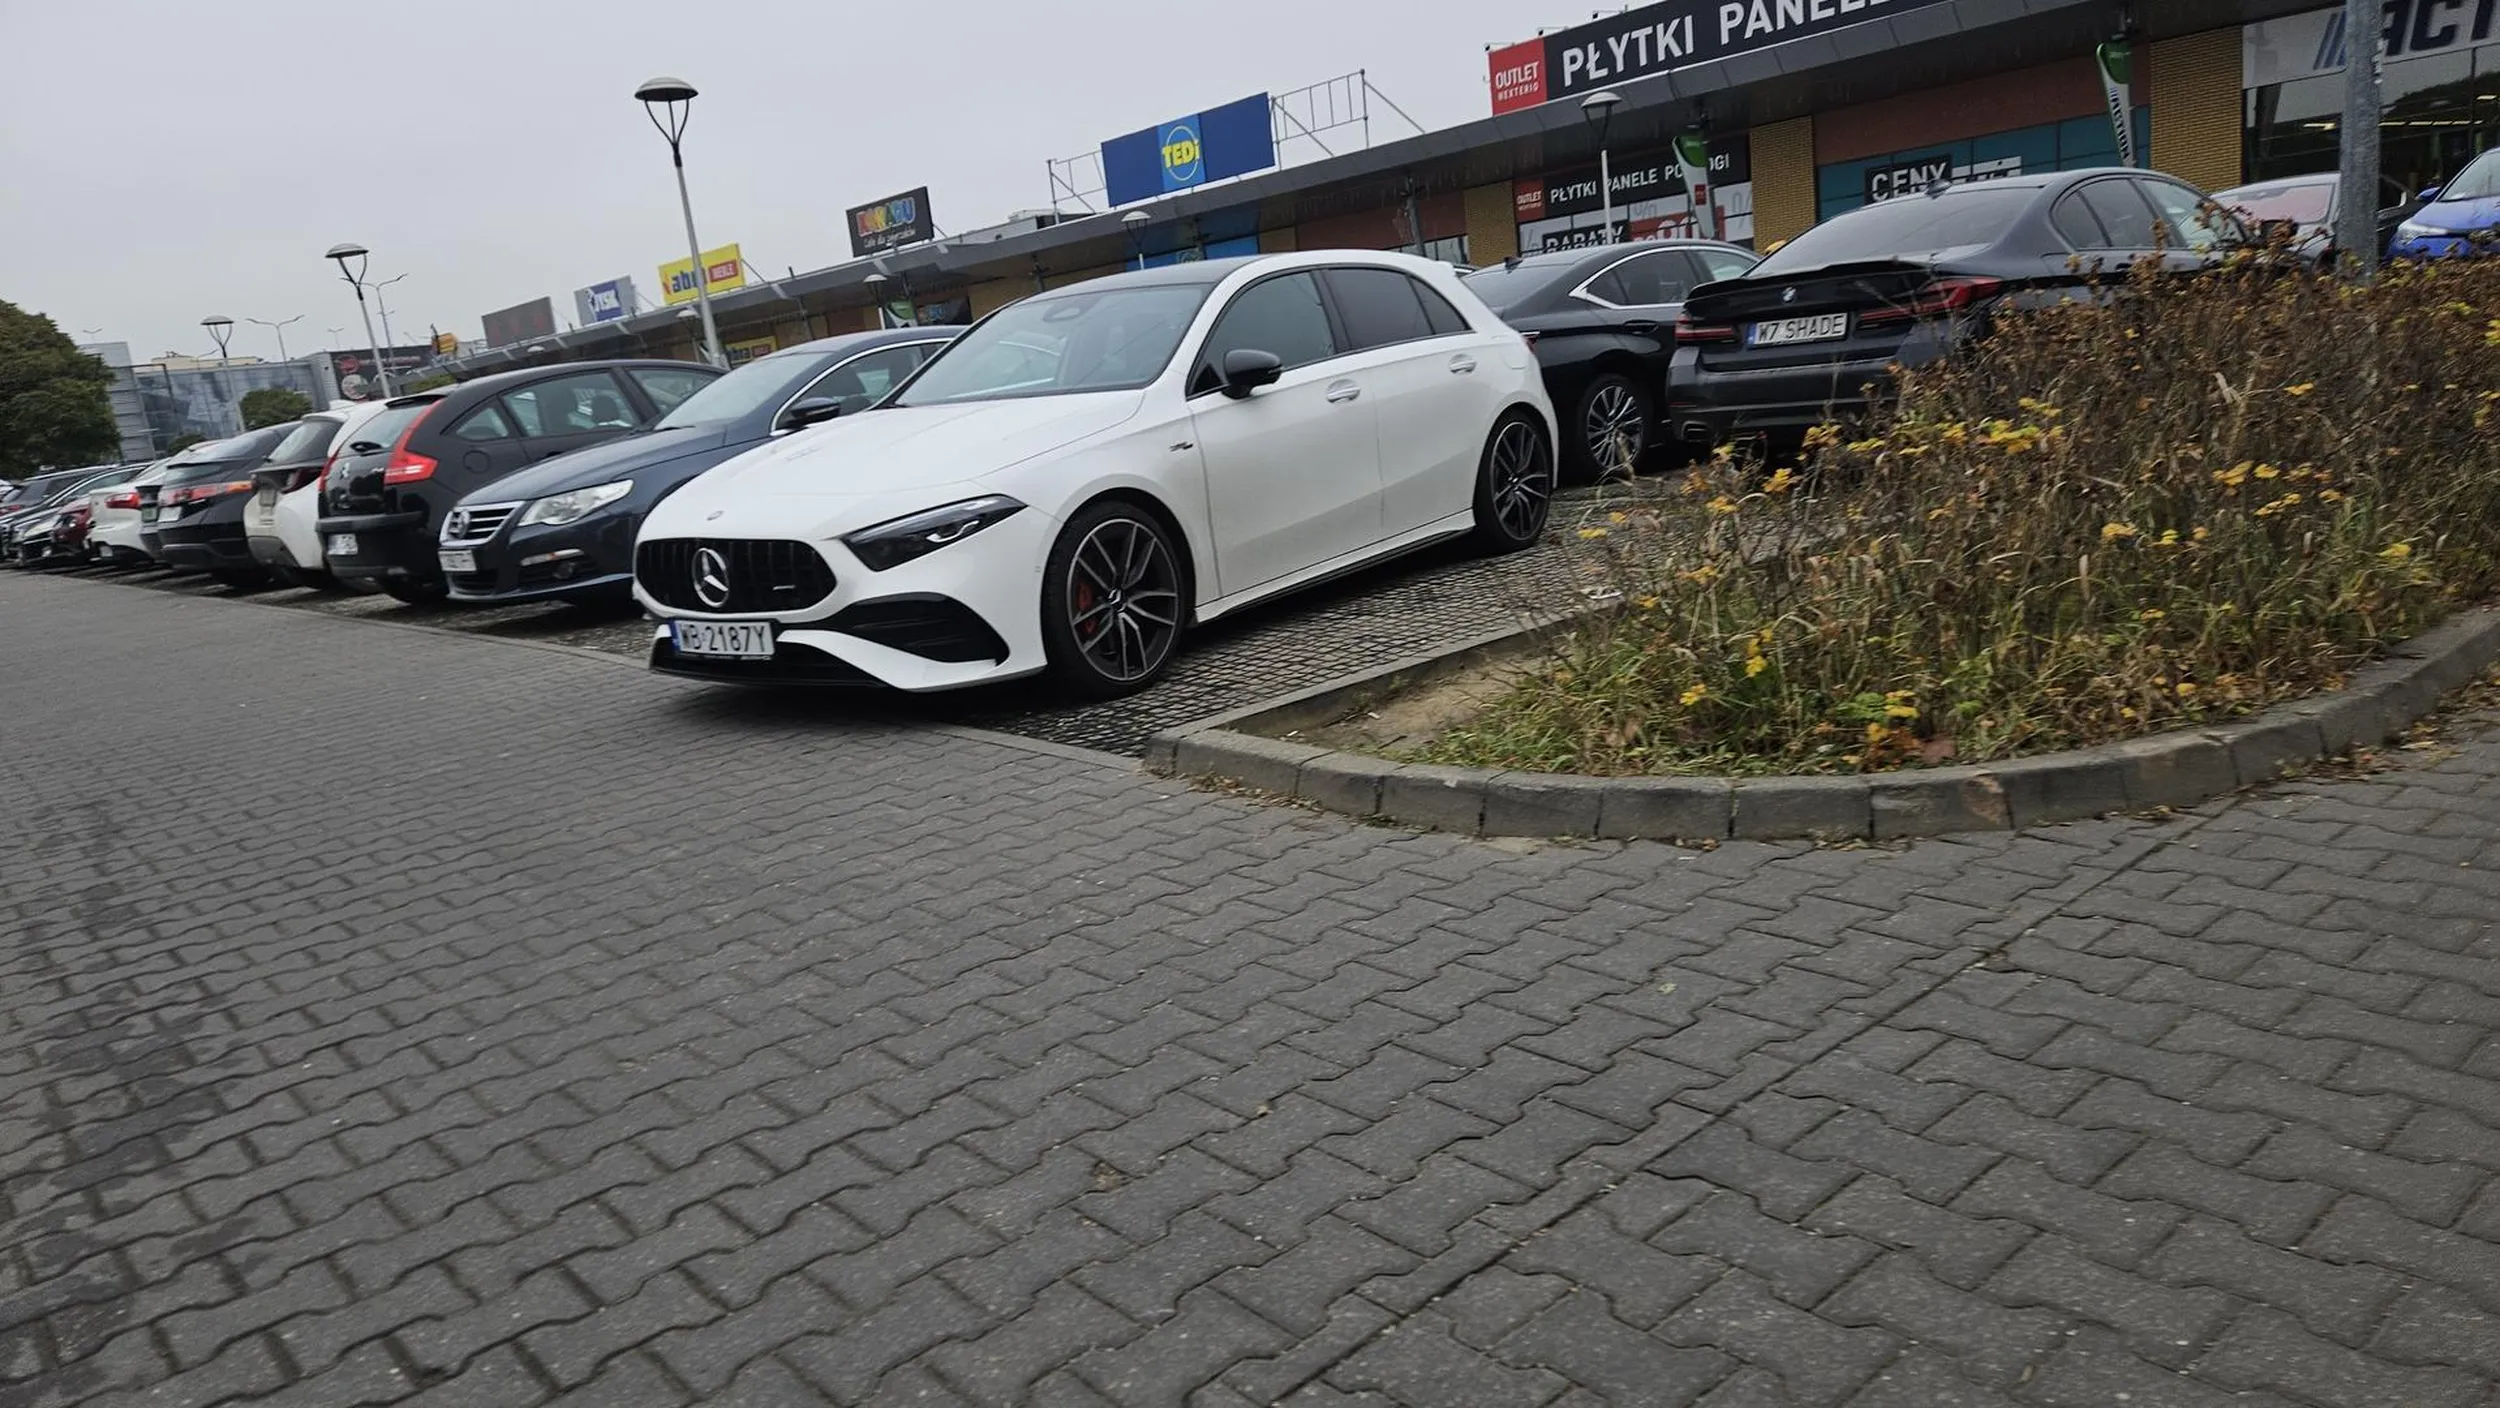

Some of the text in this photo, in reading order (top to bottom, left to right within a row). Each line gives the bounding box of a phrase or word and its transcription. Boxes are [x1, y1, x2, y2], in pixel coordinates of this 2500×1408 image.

[1562, 0, 1891, 87] PŁYTKI PANE
[1495, 60, 1540, 89] OUTLET
[1162, 138, 1200, 168] TEDi
[1550, 180, 1597, 204] PŁYTKI
[1785, 314, 1845, 340] SHADE
[705, 625, 765, 652] 2187Y
